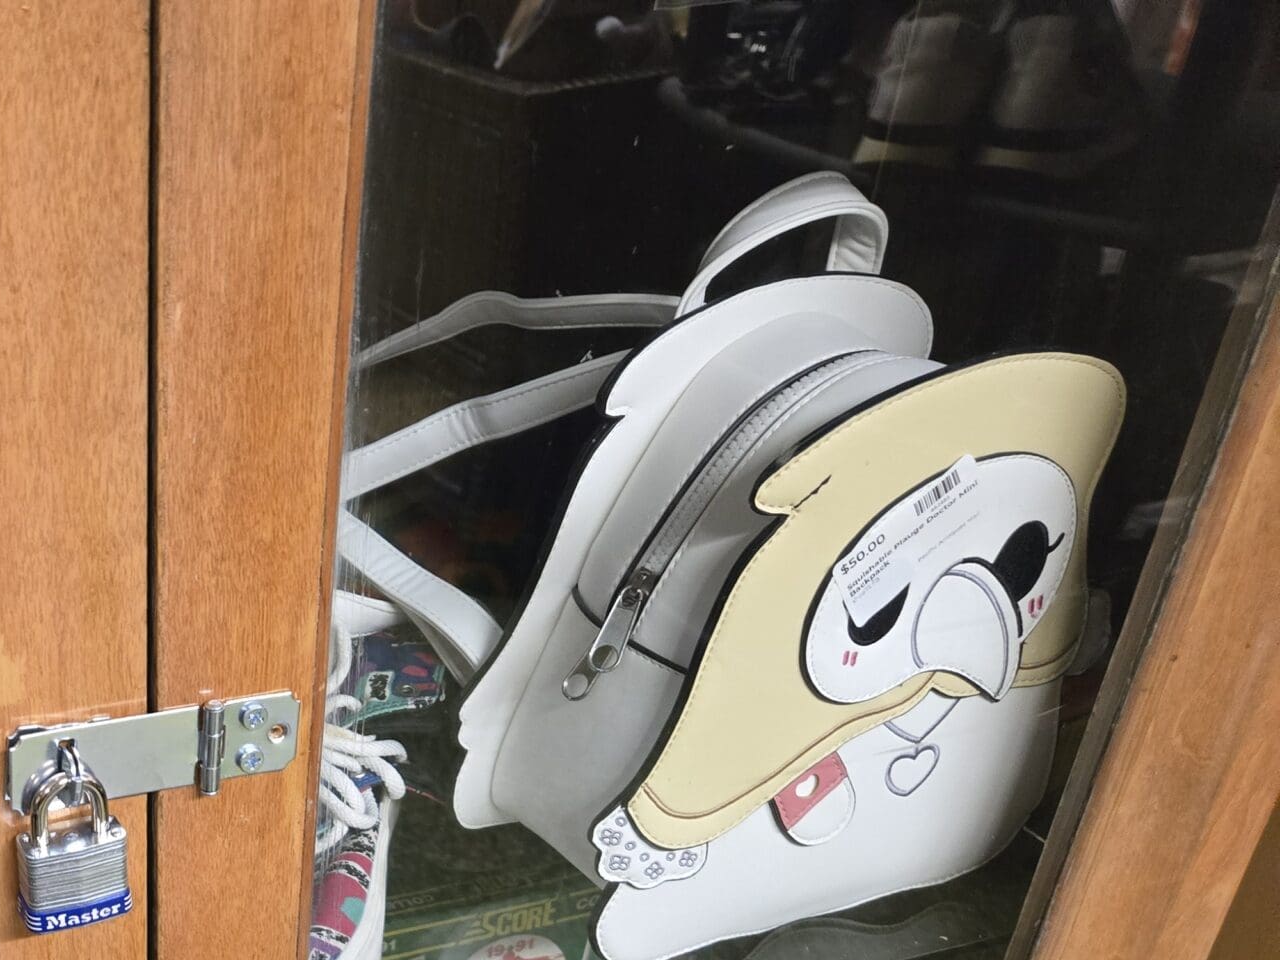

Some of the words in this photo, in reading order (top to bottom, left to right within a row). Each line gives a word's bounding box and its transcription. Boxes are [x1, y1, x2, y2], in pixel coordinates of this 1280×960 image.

[840, 533, 886, 575] $50.00
[847, 549, 892, 590] Squishable
[926, 498, 956, 524] Doctor
[958, 480, 979, 499] Mini
[849, 560, 891, 598] Backpack
[45, 903, 121, 930] Master
[476, 900, 558, 939] SCORE
